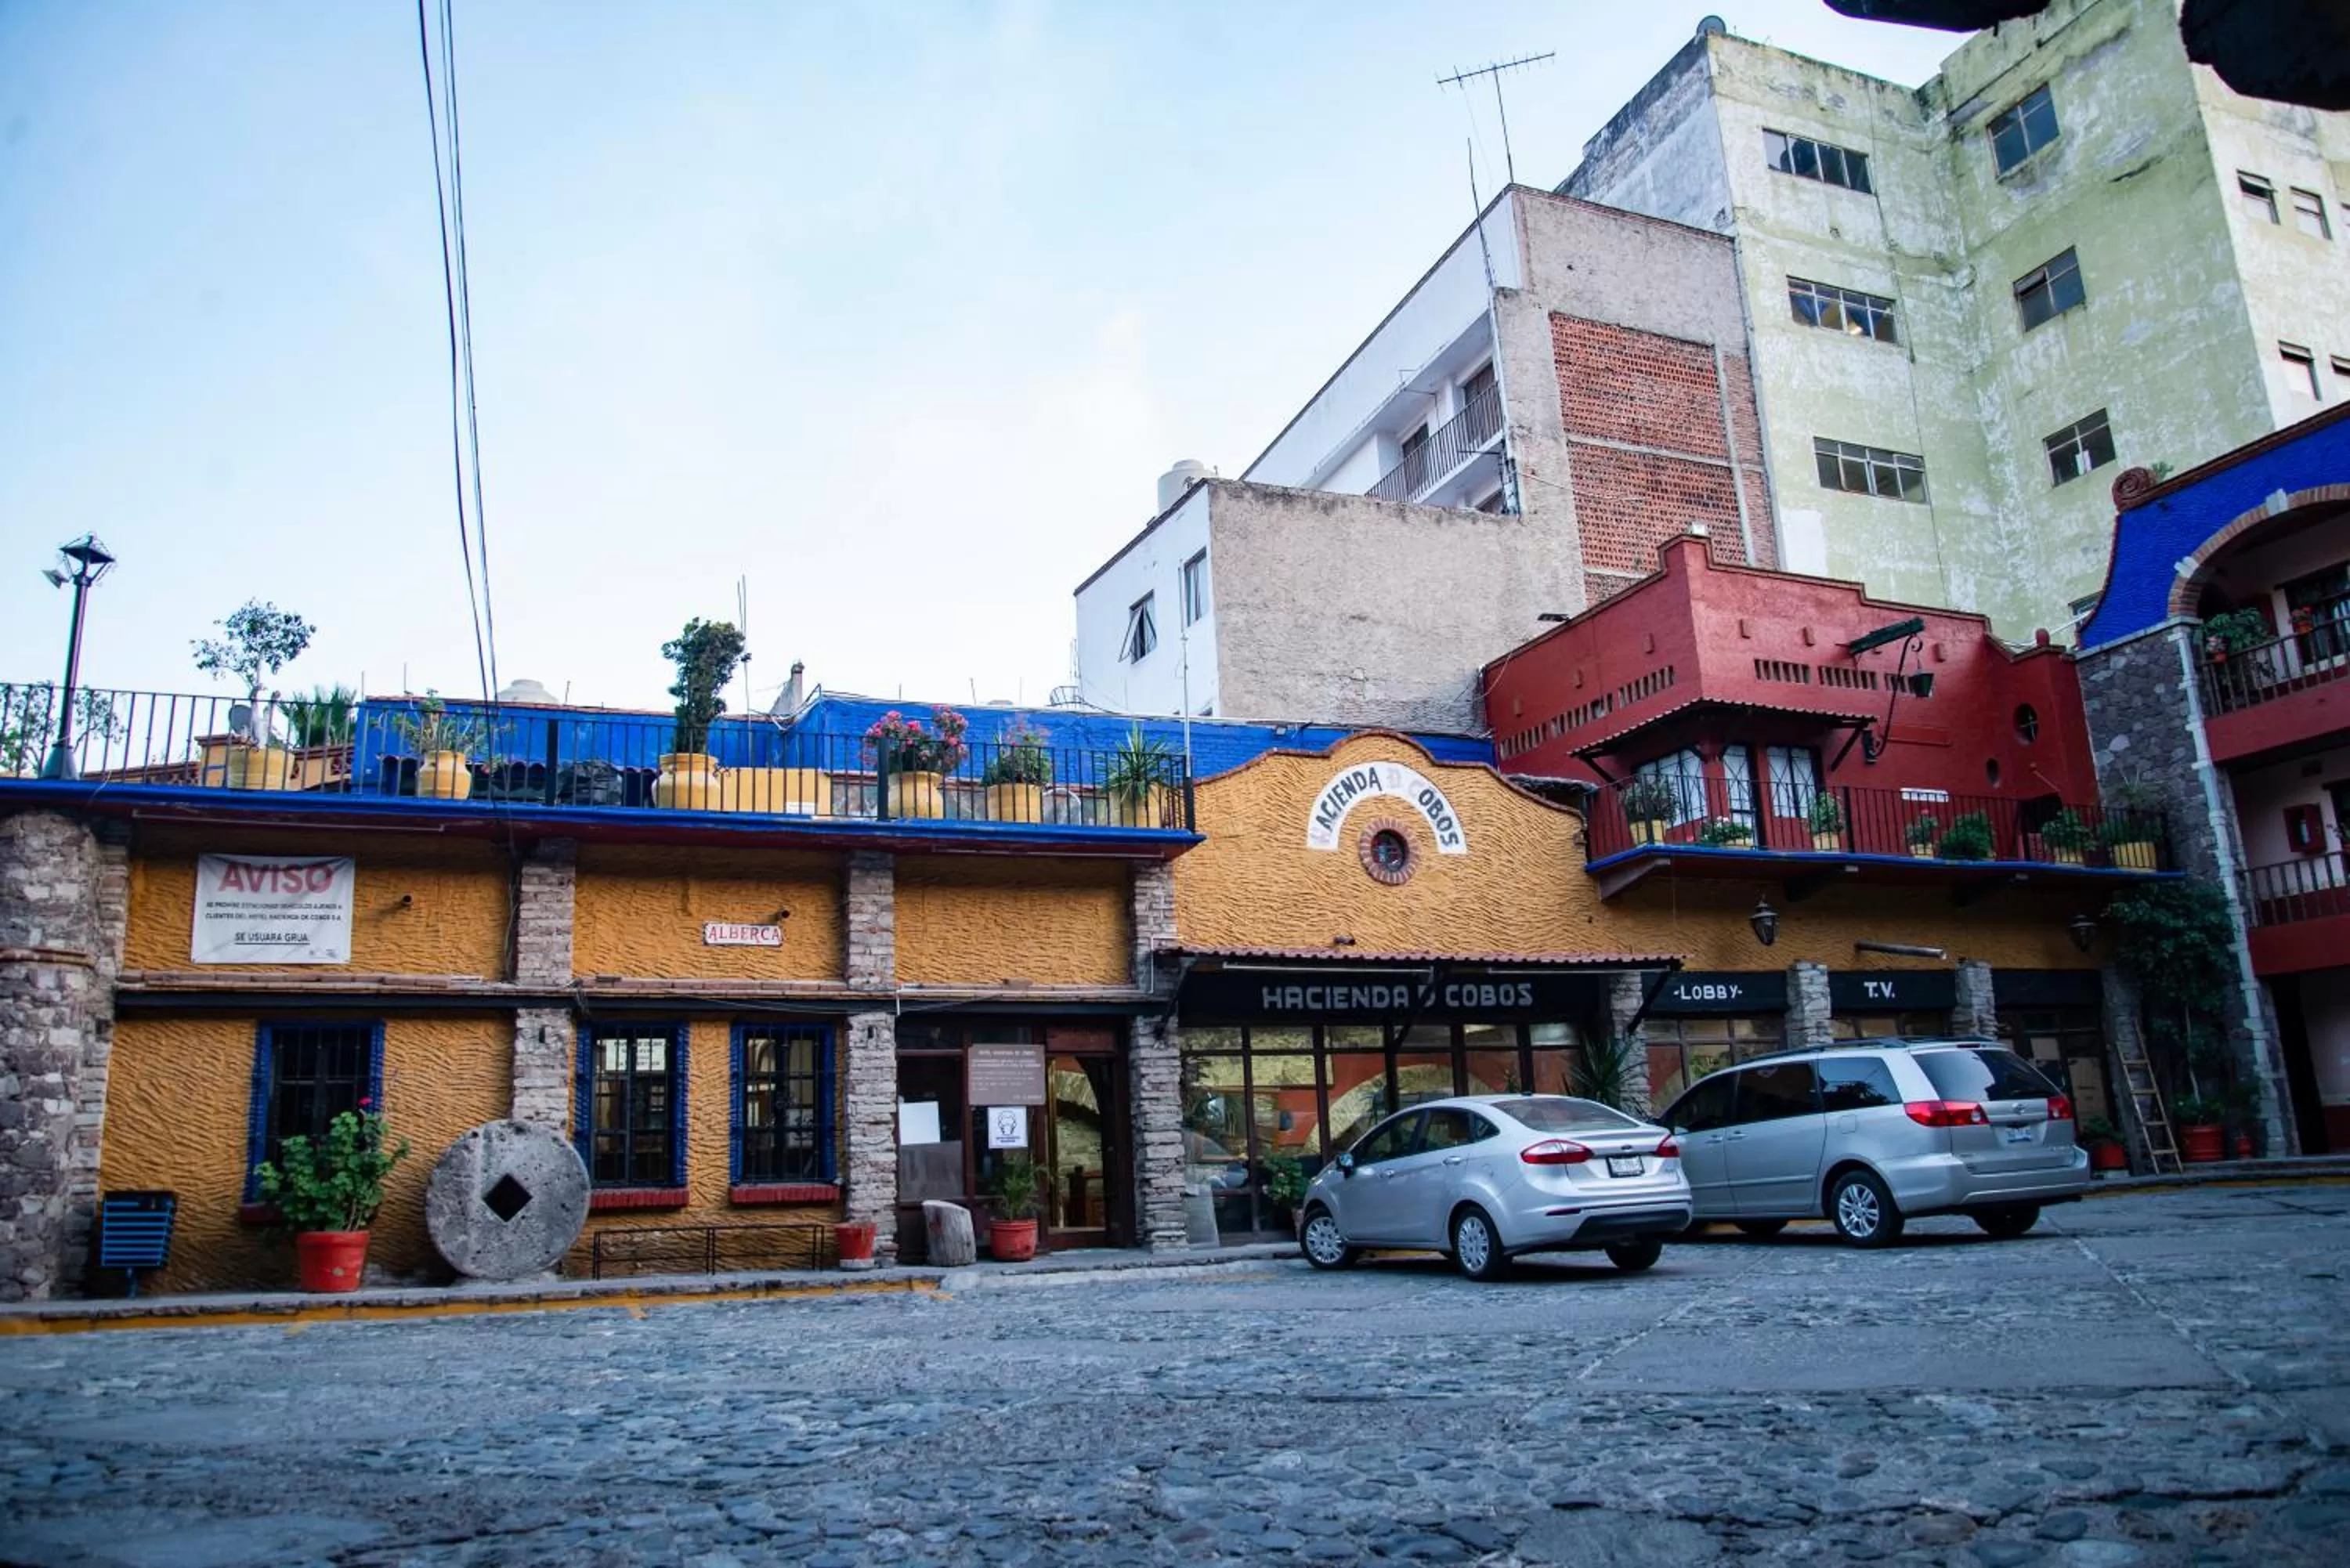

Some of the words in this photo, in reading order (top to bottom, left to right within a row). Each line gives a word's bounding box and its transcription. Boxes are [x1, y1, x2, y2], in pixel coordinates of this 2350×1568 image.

[218, 862, 334, 894] AVISO
[234, 931, 245, 941] SE
[707, 926, 779, 943] ALBERCA
[1261, 985, 1410, 1010] HACIENDA
[1444, 982, 1534, 1008] COBOS
[1864, 981, 1896, 999] T.V.
